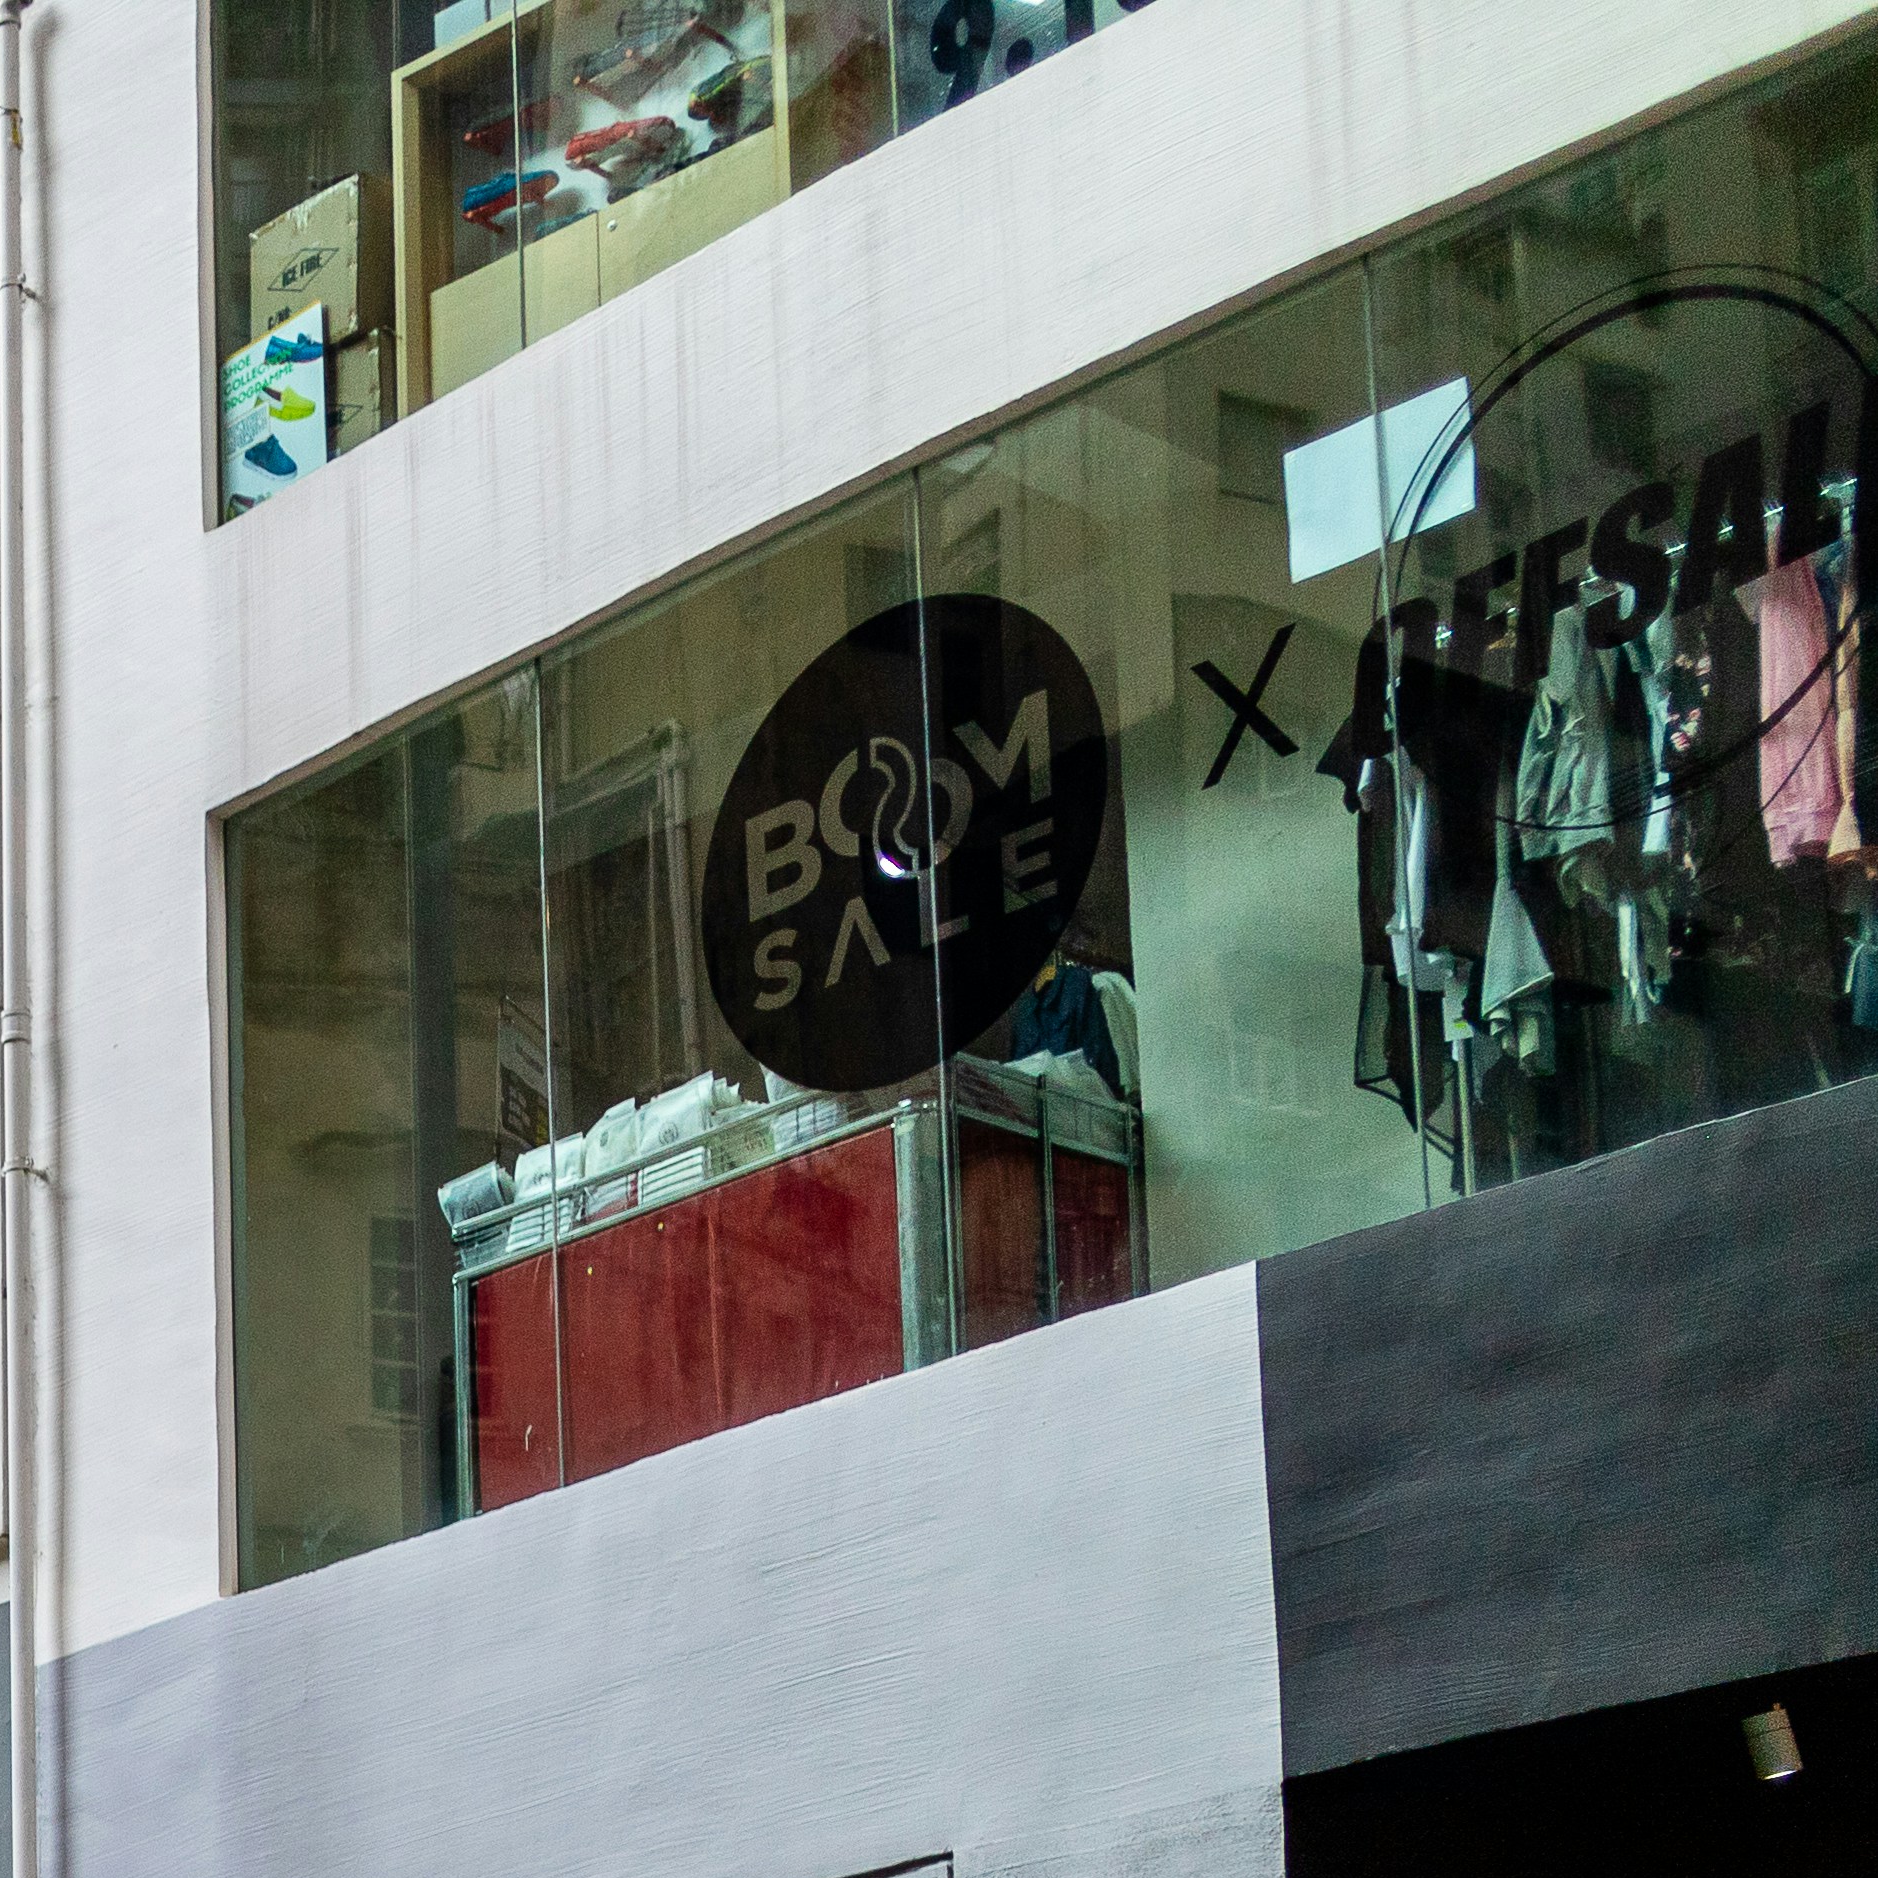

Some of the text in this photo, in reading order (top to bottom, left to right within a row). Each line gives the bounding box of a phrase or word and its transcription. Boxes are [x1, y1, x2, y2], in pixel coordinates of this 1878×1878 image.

[281, 253, 323, 289] ICE FIRE
[222, 355, 251, 380] SHOE
[224, 362, 294, 411] PROGRAMME
[1352, 378, 1878, 766] OFFSAL
[744, 689, 1052, 923] BOOM
[753, 816, 1059, 1011] SALE
